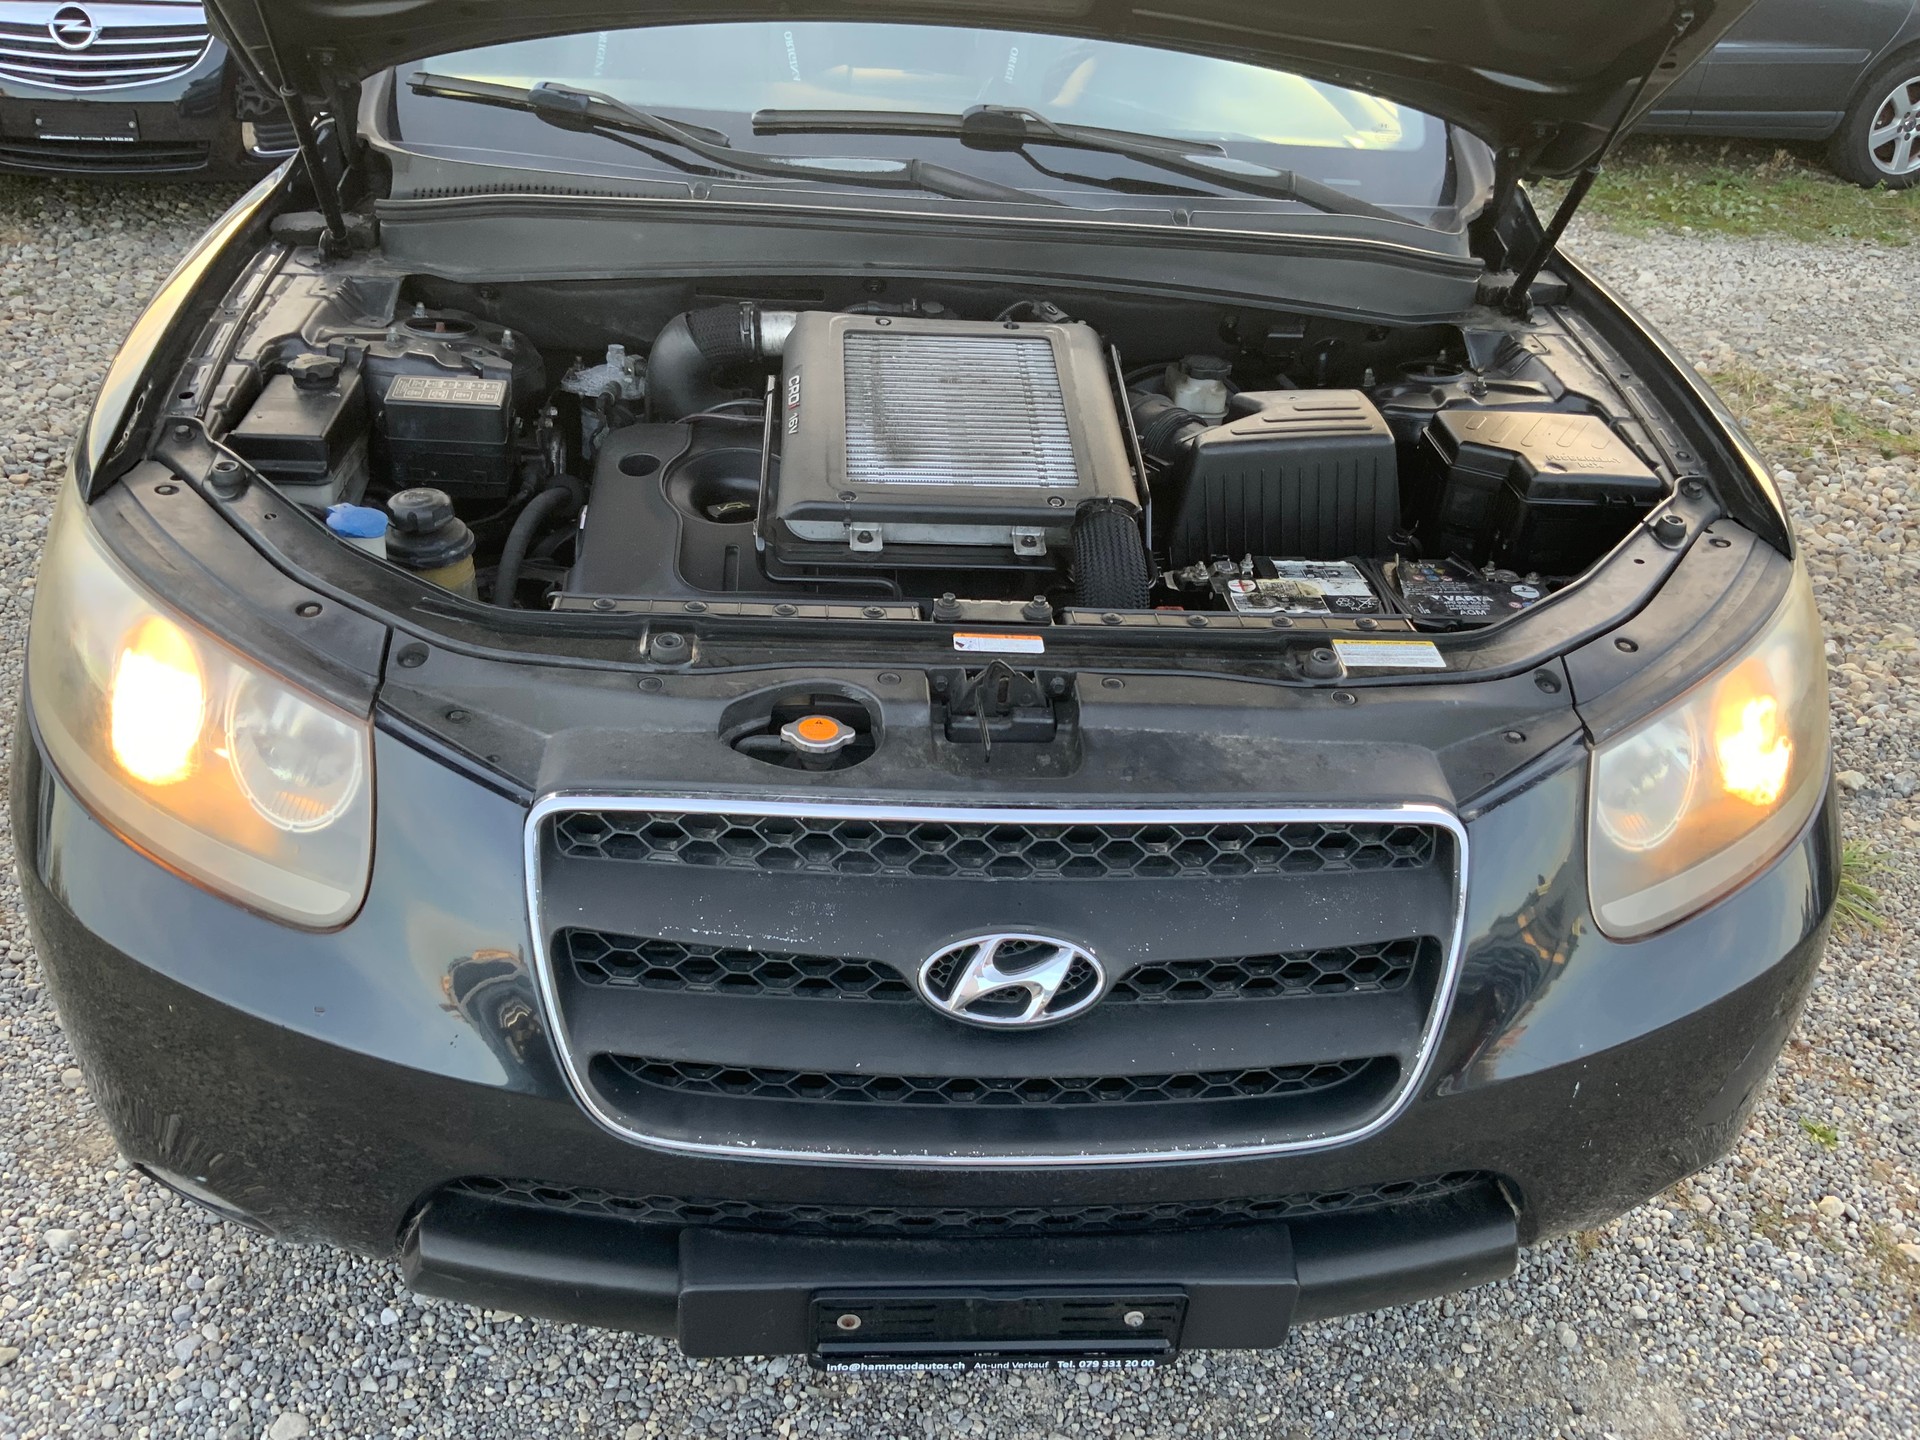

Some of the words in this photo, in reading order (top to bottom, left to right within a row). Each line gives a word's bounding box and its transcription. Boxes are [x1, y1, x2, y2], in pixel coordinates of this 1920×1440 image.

[788, 412, 799, 435] 16V
[973, 1361, 1009, 1370] An-und
[1011, 1361, 1050, 1369] Verkauf
[1057, 1360, 1076, 1369] Tel.
[1078, 1360, 1100, 1368] 079
[1101, 1360, 1122, 1368] 331
[1124, 1360, 1139, 1368] 20
[1140, 1359, 1155, 1368] 00
